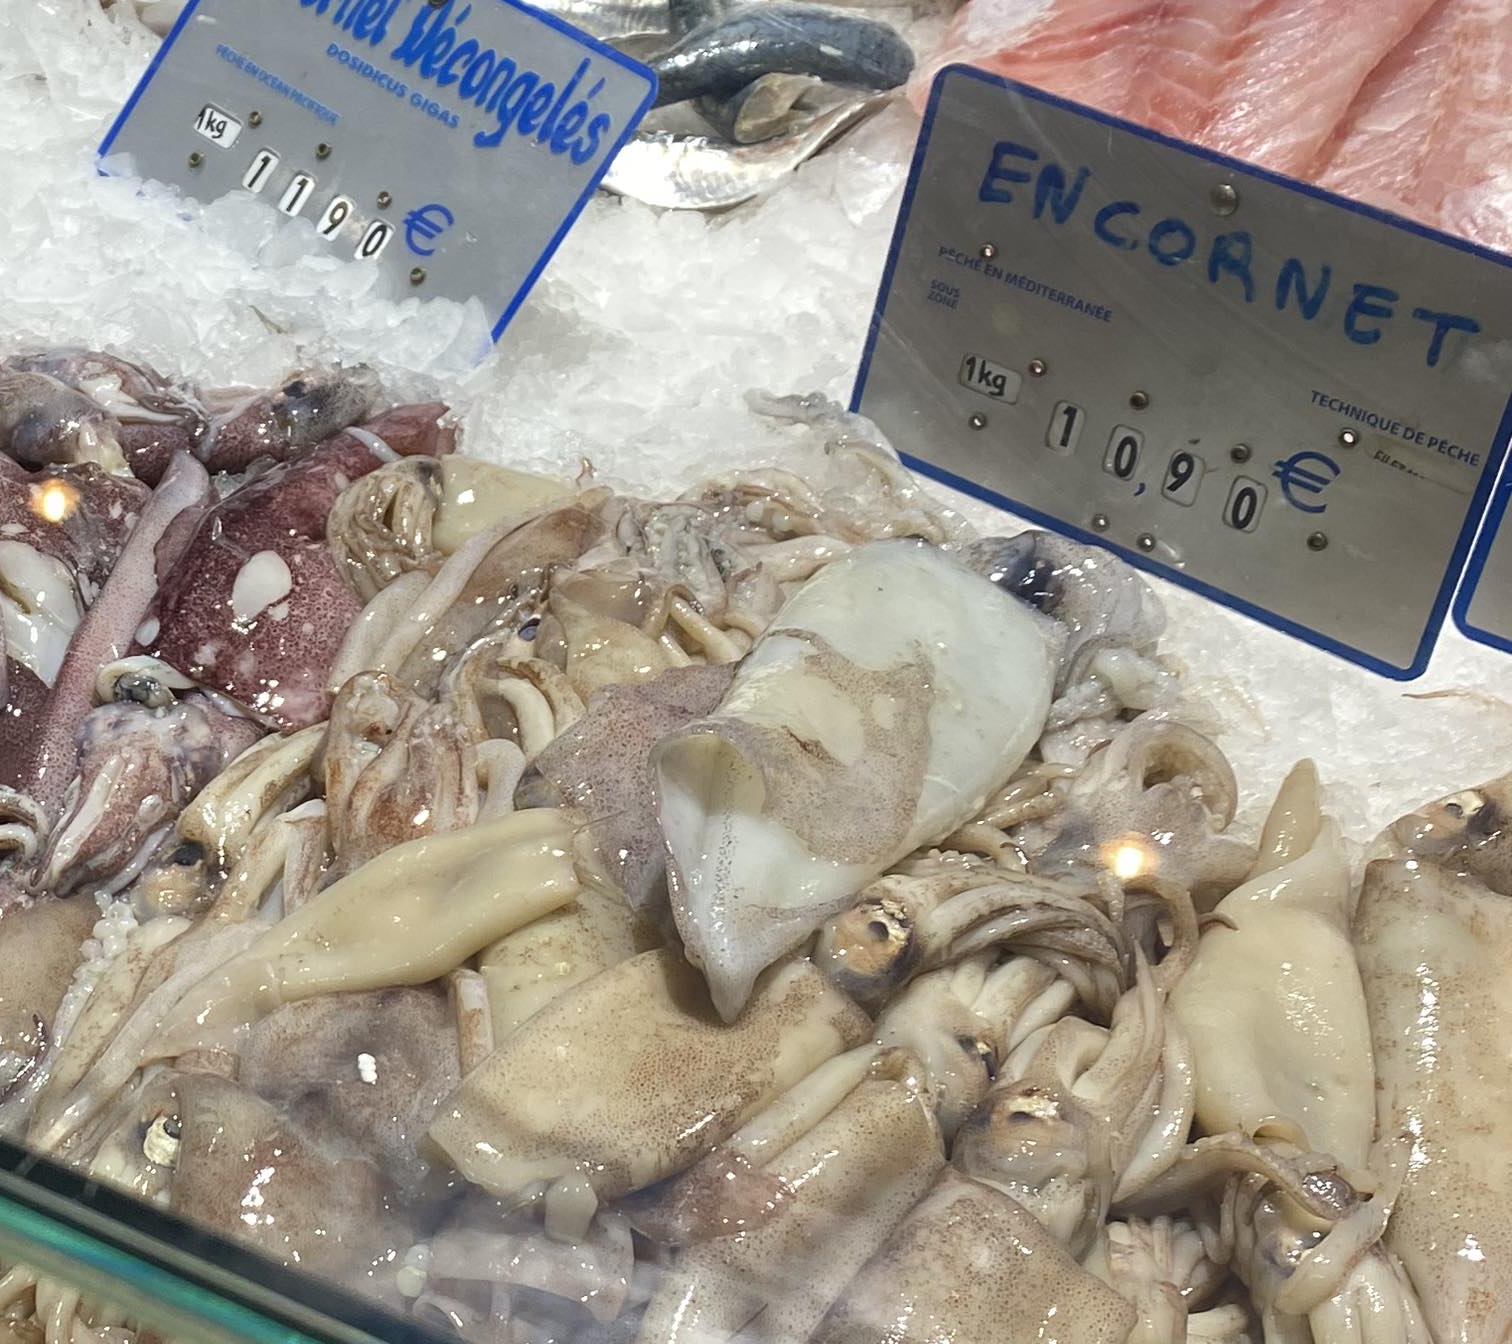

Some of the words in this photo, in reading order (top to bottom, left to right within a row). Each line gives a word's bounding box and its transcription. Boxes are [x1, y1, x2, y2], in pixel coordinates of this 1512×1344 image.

[326, 42, 409, 99] DOSIDICUS
[410, 92, 461, 129] GIGAS
[196, 107, 227, 139] 1kg
[402, 204, 455, 256] €
[930, 279, 960, 298] SOUS
[977, 140, 1483, 367] ENCORNET
[927, 292, 959, 310] ZONE
[983, 263, 1004, 280] EN
[1004, 272, 1113, 323] MÉDITERRANÉE
[966, 356, 1007, 397] 1kg
[1059, 405, 1258, 531] 10,90
[1271, 451, 1341, 513] €
[1311, 389, 1402, 436] TECHNIQUE
[1402, 426, 1428, 446] DE
